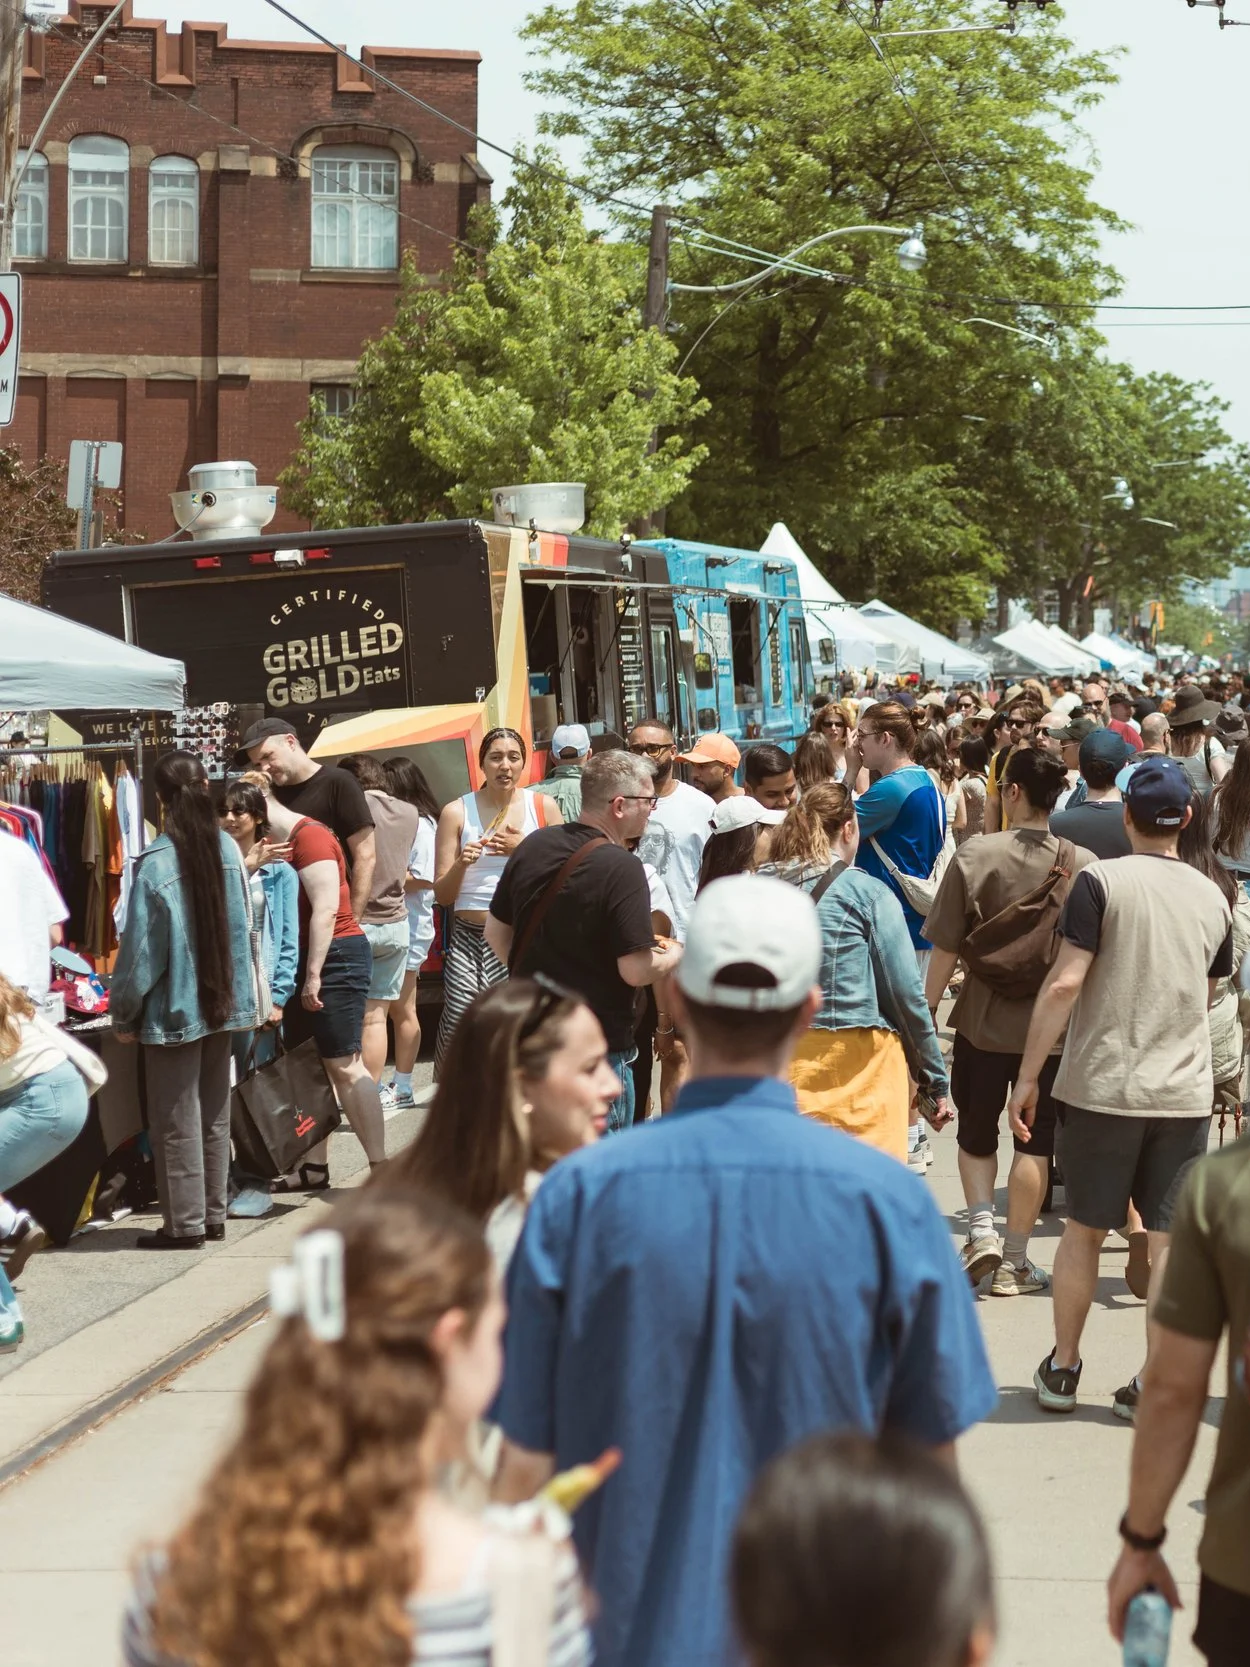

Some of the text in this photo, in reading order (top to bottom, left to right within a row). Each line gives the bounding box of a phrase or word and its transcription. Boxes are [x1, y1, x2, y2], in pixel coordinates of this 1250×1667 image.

[270, 589, 385, 625] CERTIFIED
[263, 622, 404, 675] GRILLED
[363, 666, 401, 686] Eats
[92, 723, 114, 735] WE
